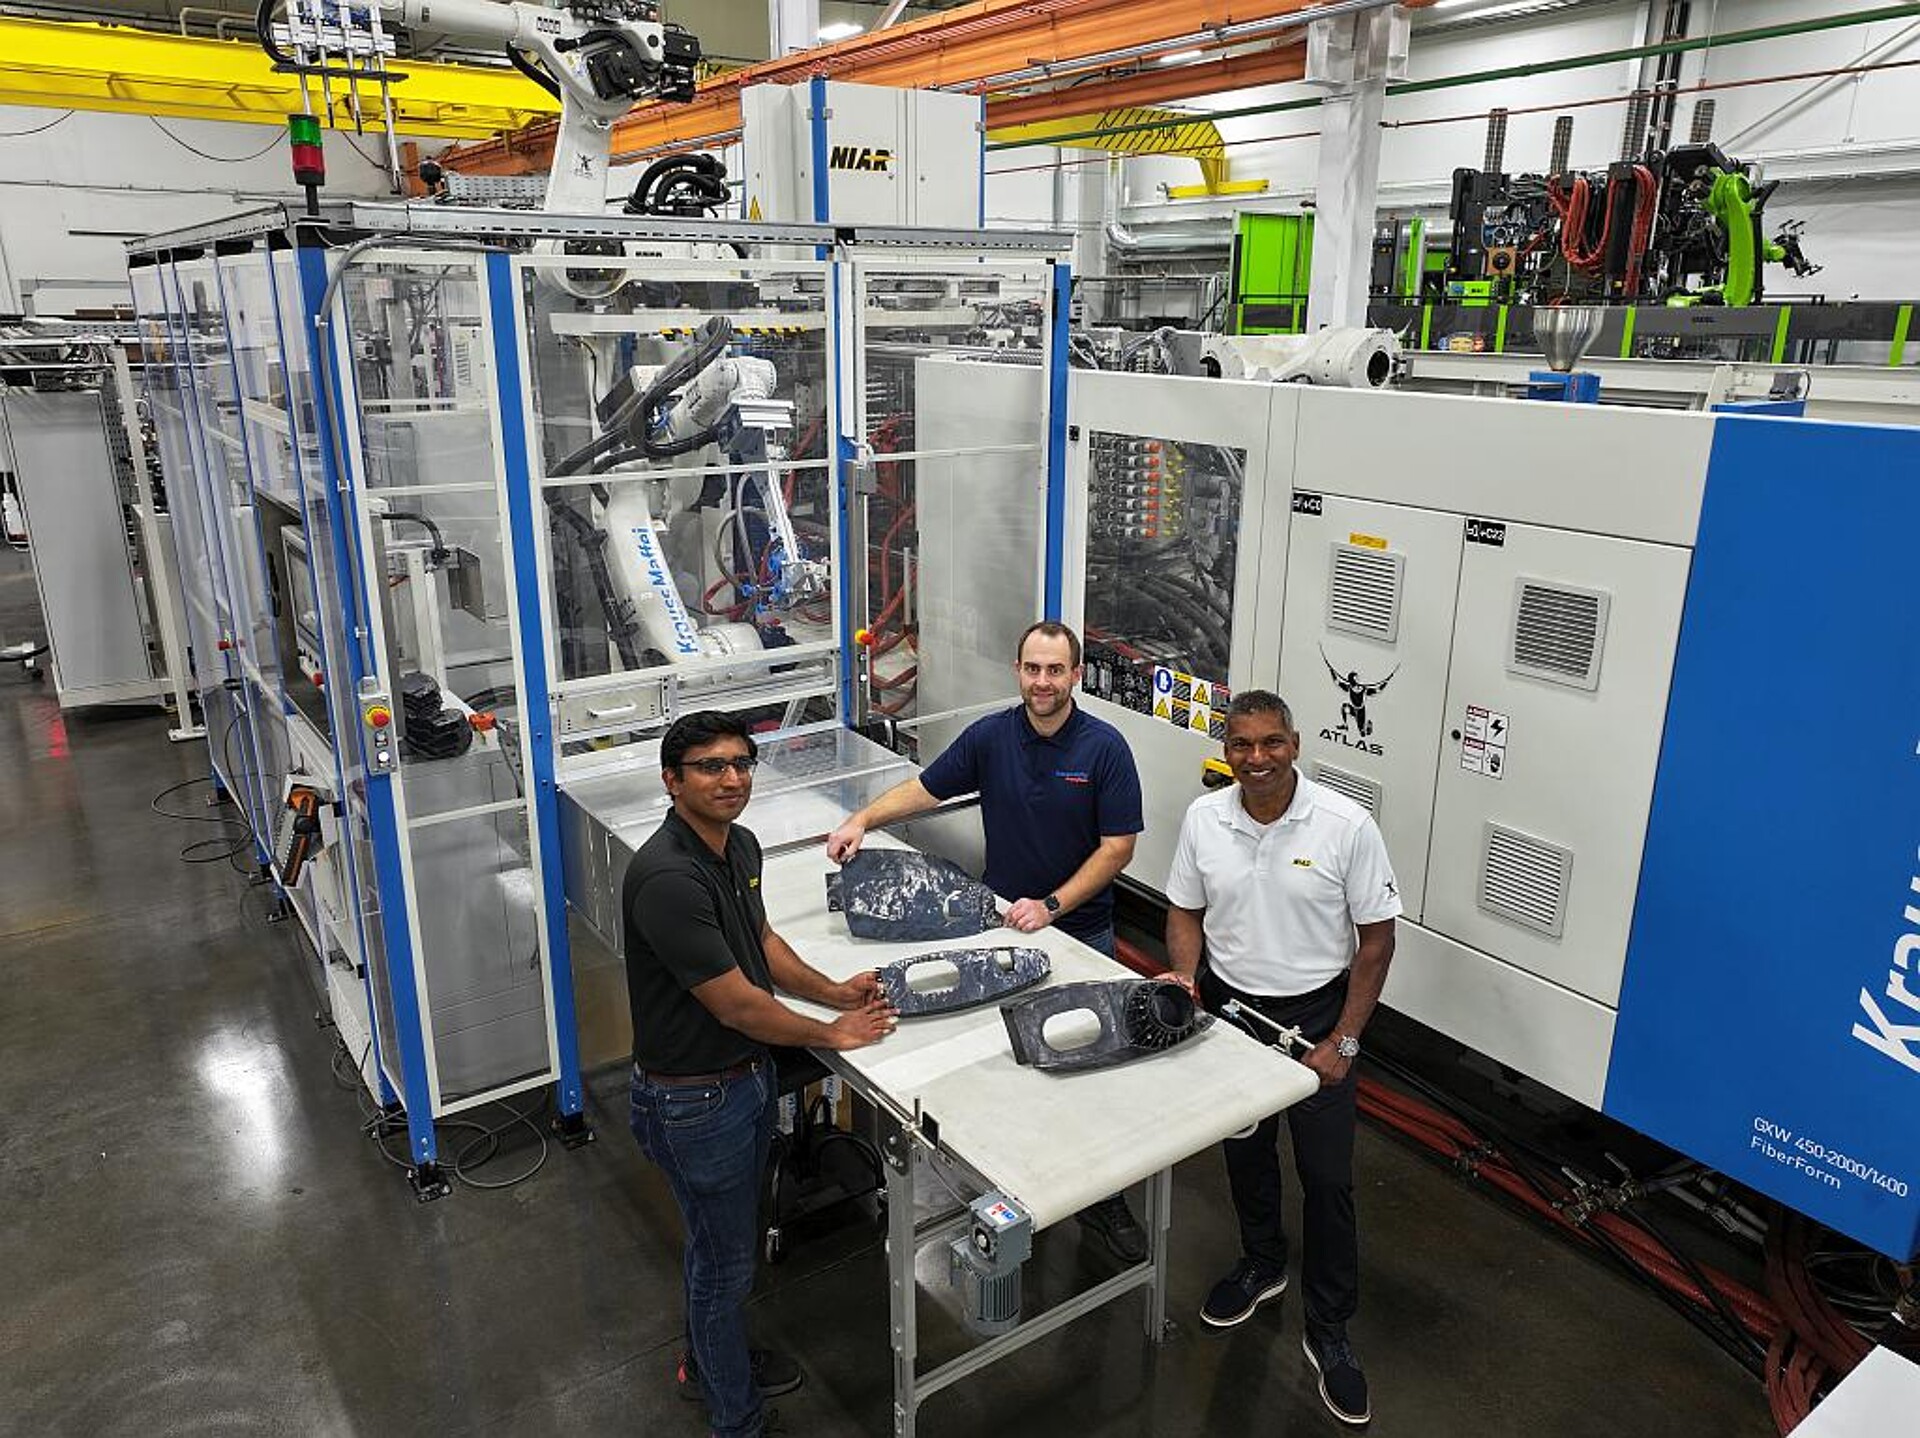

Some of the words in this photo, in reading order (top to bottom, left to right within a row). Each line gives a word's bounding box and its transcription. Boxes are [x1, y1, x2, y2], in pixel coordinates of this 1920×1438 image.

[830, 146, 897, 171] NIAR
[1319, 728, 1383, 756] ATLAS
[1751, 1136, 1841, 1189] FiberForm
[1754, 1117, 1792, 1143] GXW
[1795, 1137, 1908, 1197] 450-2000/1400
